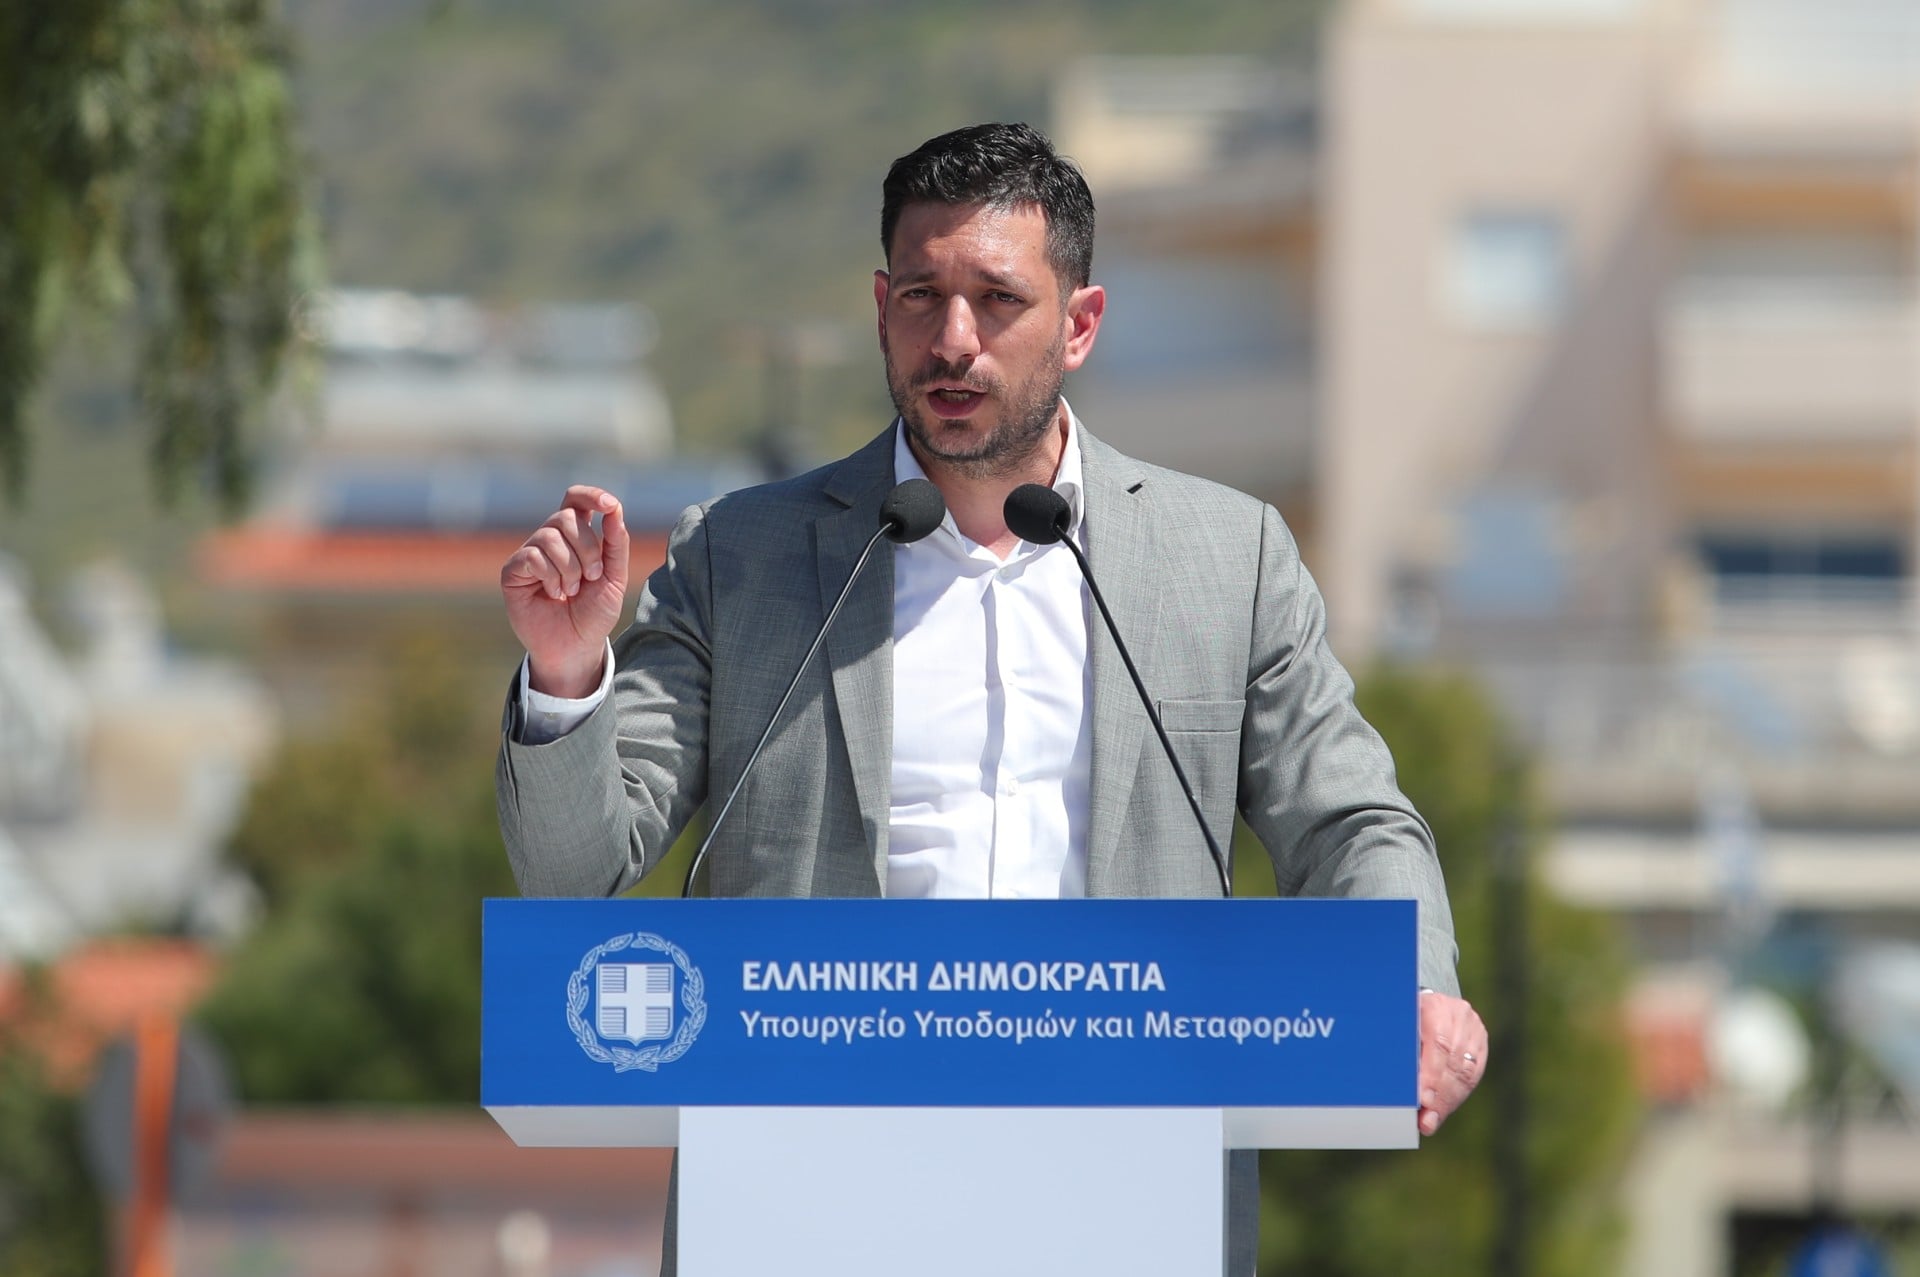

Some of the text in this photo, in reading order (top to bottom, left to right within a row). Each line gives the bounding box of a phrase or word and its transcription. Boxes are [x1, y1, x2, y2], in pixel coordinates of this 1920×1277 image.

[742, 961, 1165, 991] ΕΛΛΗΝΙΚΗ ΔΗΜΟΚΡΑΤΙΑ
[740, 1008, 1334, 1044] Υπουργείο Υποδομών και Μεταφορών
